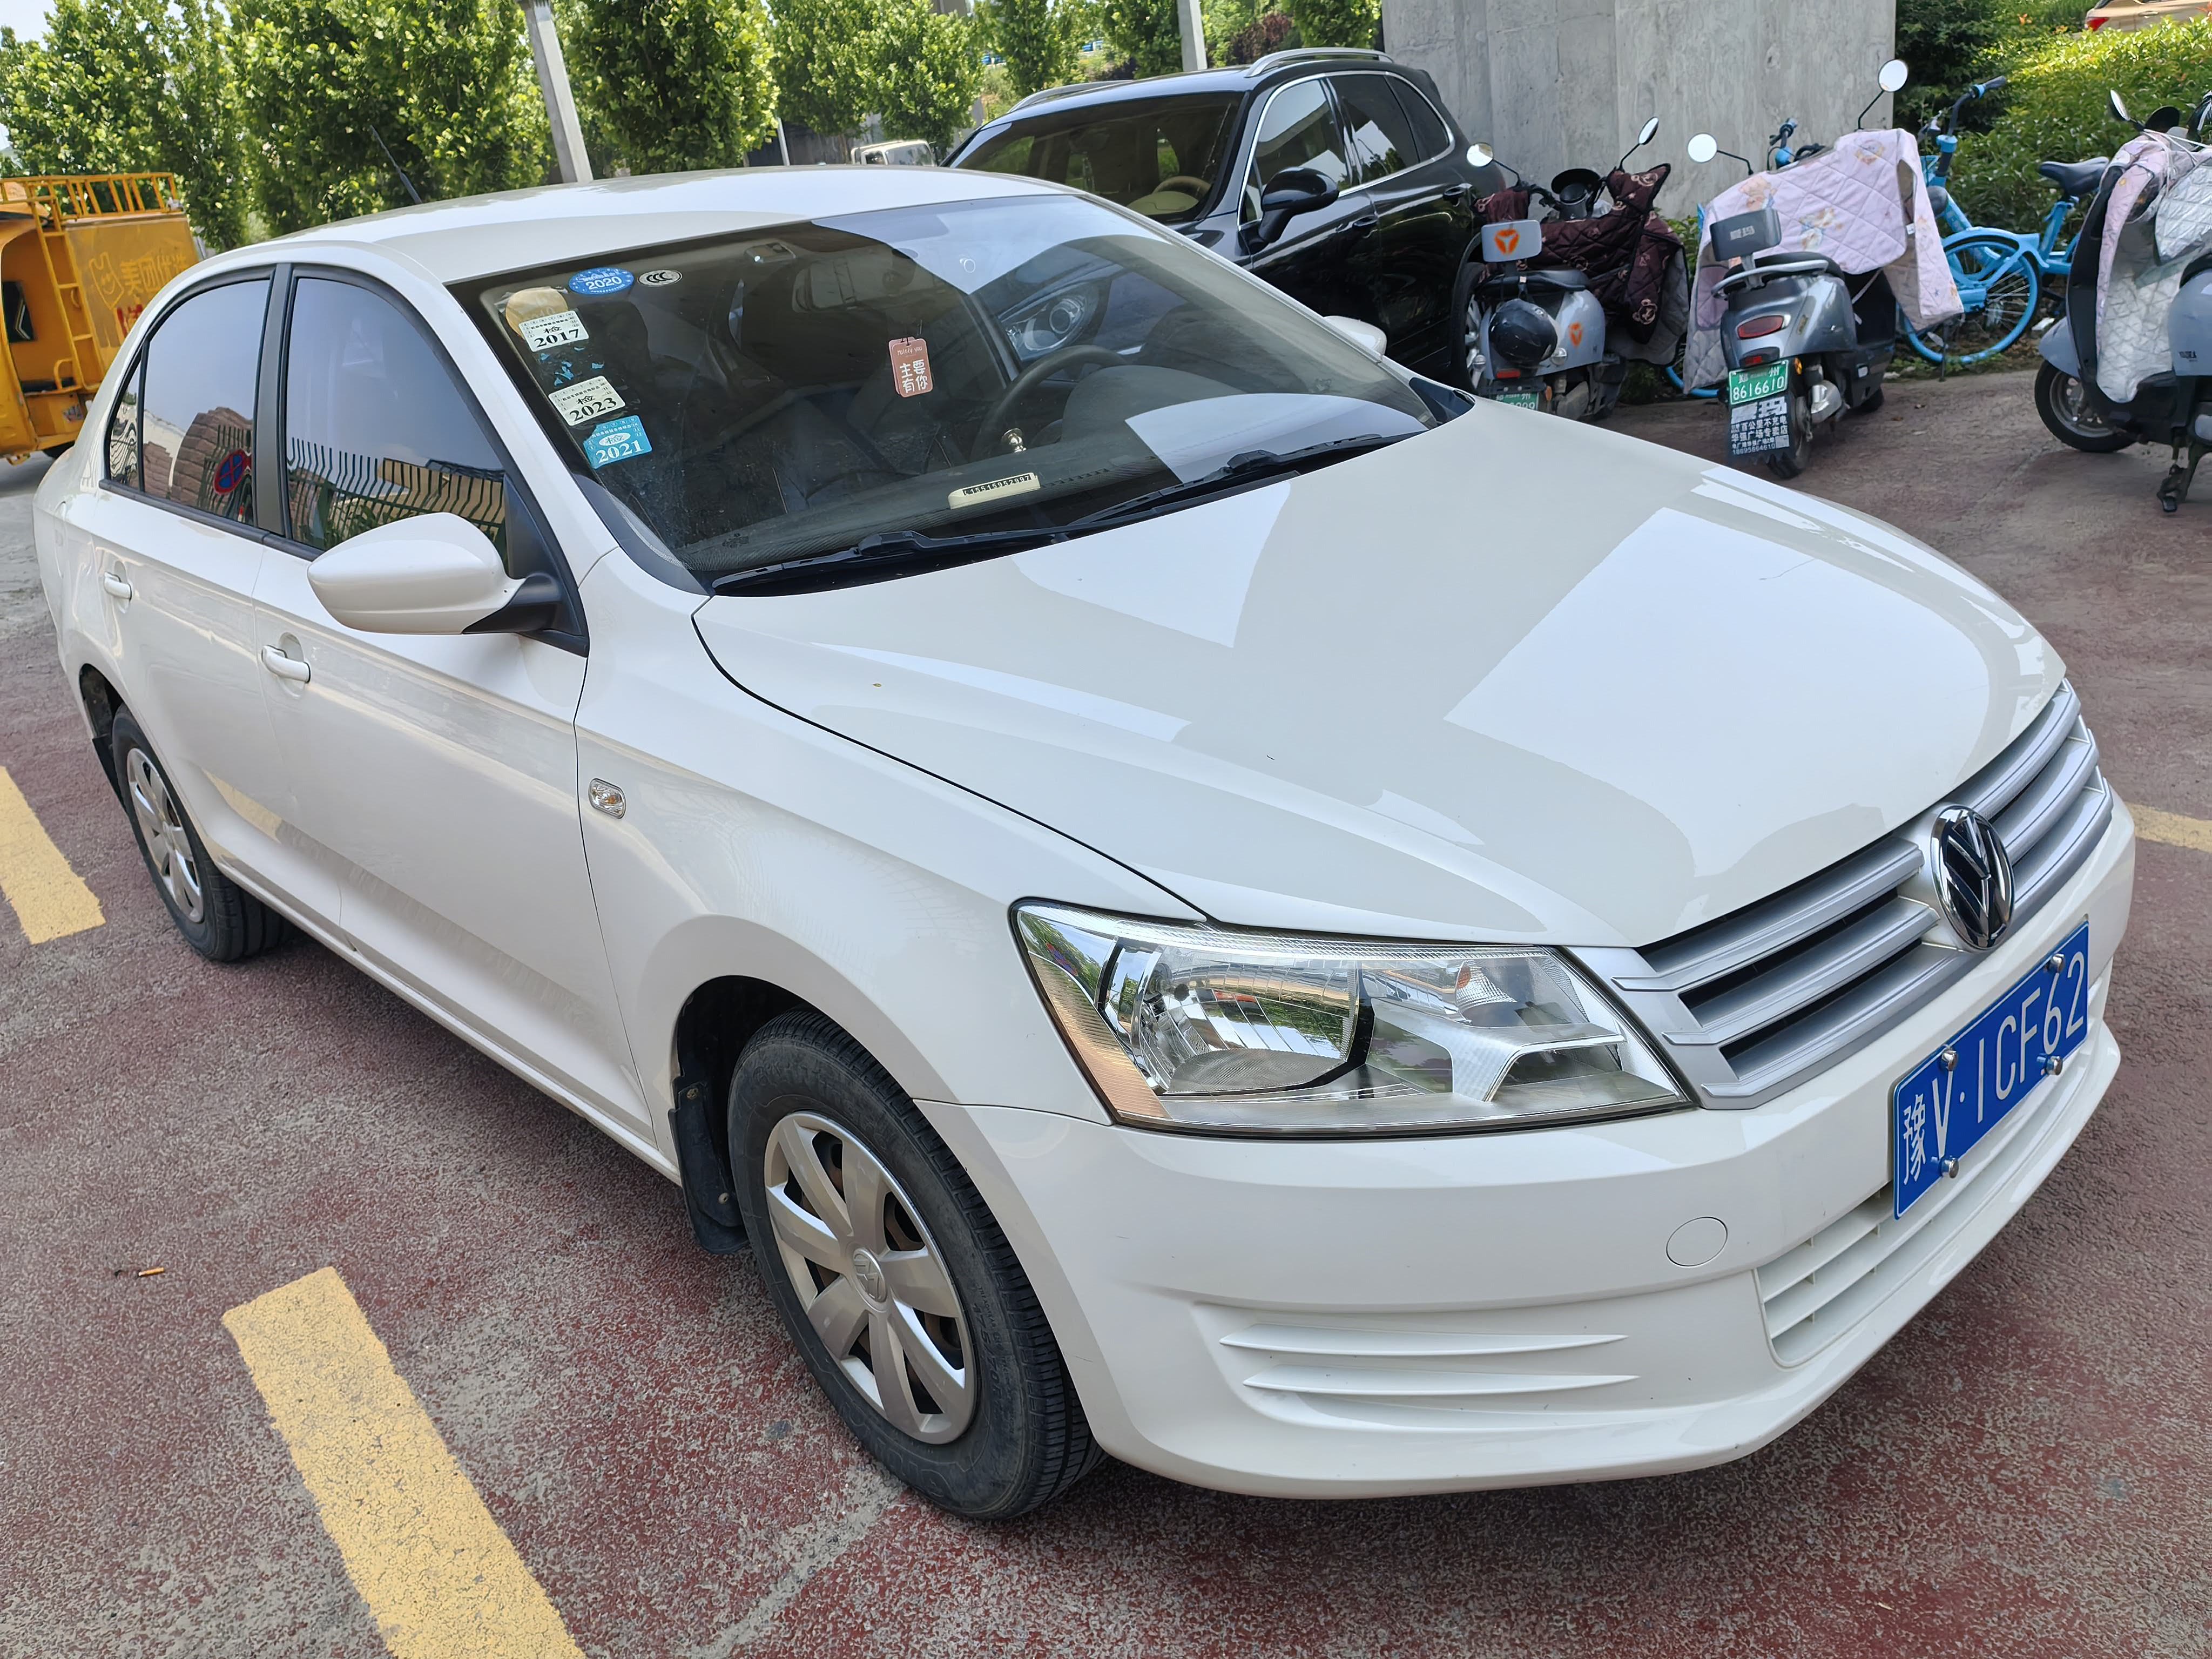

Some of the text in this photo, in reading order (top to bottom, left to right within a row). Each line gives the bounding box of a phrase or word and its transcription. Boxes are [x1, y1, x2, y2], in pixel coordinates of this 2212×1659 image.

[585, 276, 622, 290] 2020
[534, 328, 579, 348] 2017
[1732, 376, 1784, 401] 8616610
[569, 397, 617, 422] 2023
[596, 440, 644, 464] 2021
[970, 475, 1029, 495] 15515952997
